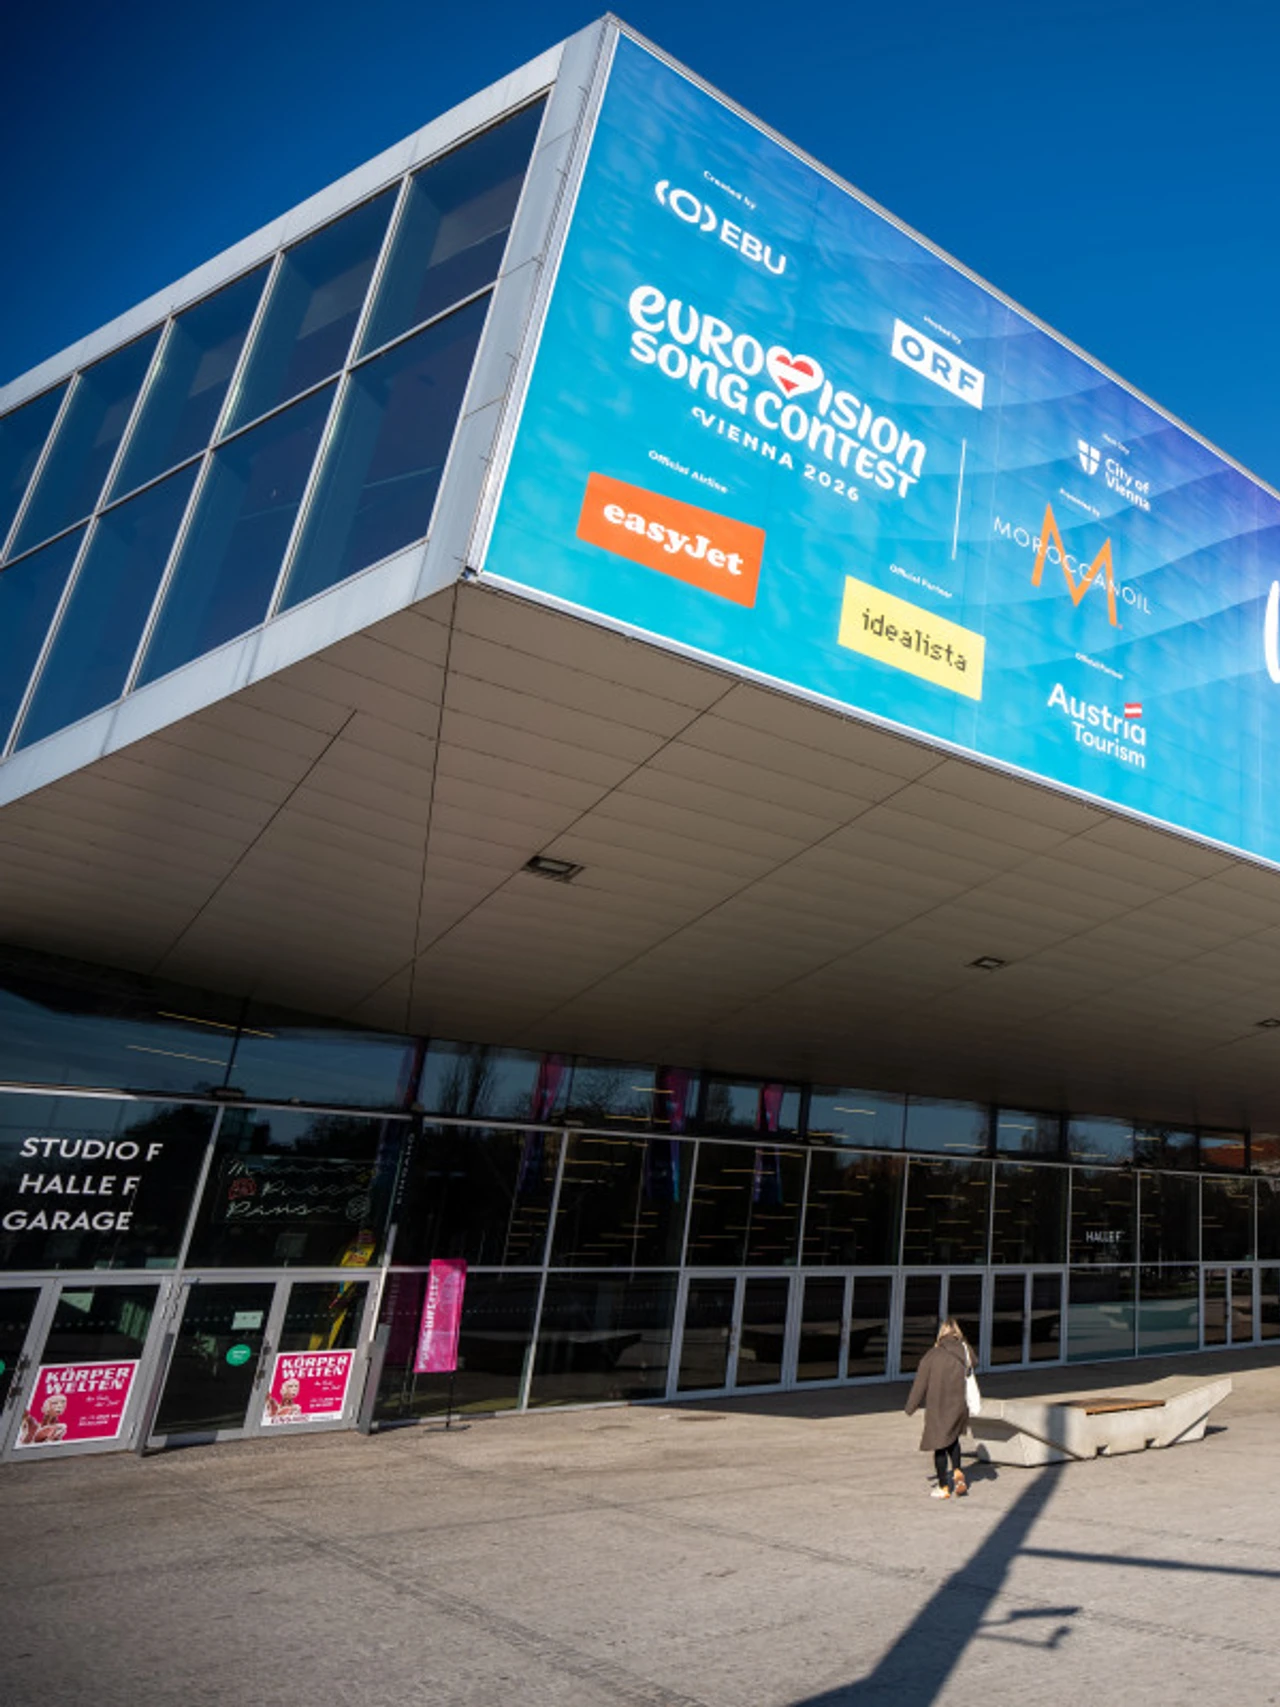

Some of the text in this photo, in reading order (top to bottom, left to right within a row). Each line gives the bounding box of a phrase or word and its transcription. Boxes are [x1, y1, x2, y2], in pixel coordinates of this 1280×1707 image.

[719, 218, 787, 276] EBU
[900, 334, 978, 391] ORF
[648, 449, 690, 476] Official
[690, 405, 860, 503] VIENNA 2026
[1104, 457, 1151, 495] City of
[1104, 471, 1151, 512] Vienna
[602, 503, 744, 576] easyJet
[993, 516, 1152, 616] MOROCCANOIL
[861, 607, 968, 673] idealista
[1046, 682, 1147, 747] Austria
[1071, 720, 1146, 770] Tourism
[19, 1136, 164, 1162] STUDIO F
[18, 1173, 142, 1196] HALLE F
[2, 1209, 134, 1231] GARAGE
[44, 1366, 131, 1384] KÖRPER
[281, 1354, 349, 1369] KÖRPER
[281, 1366, 345, 1380] WELTEN
[45, 1379, 125, 1395] WELTEN
